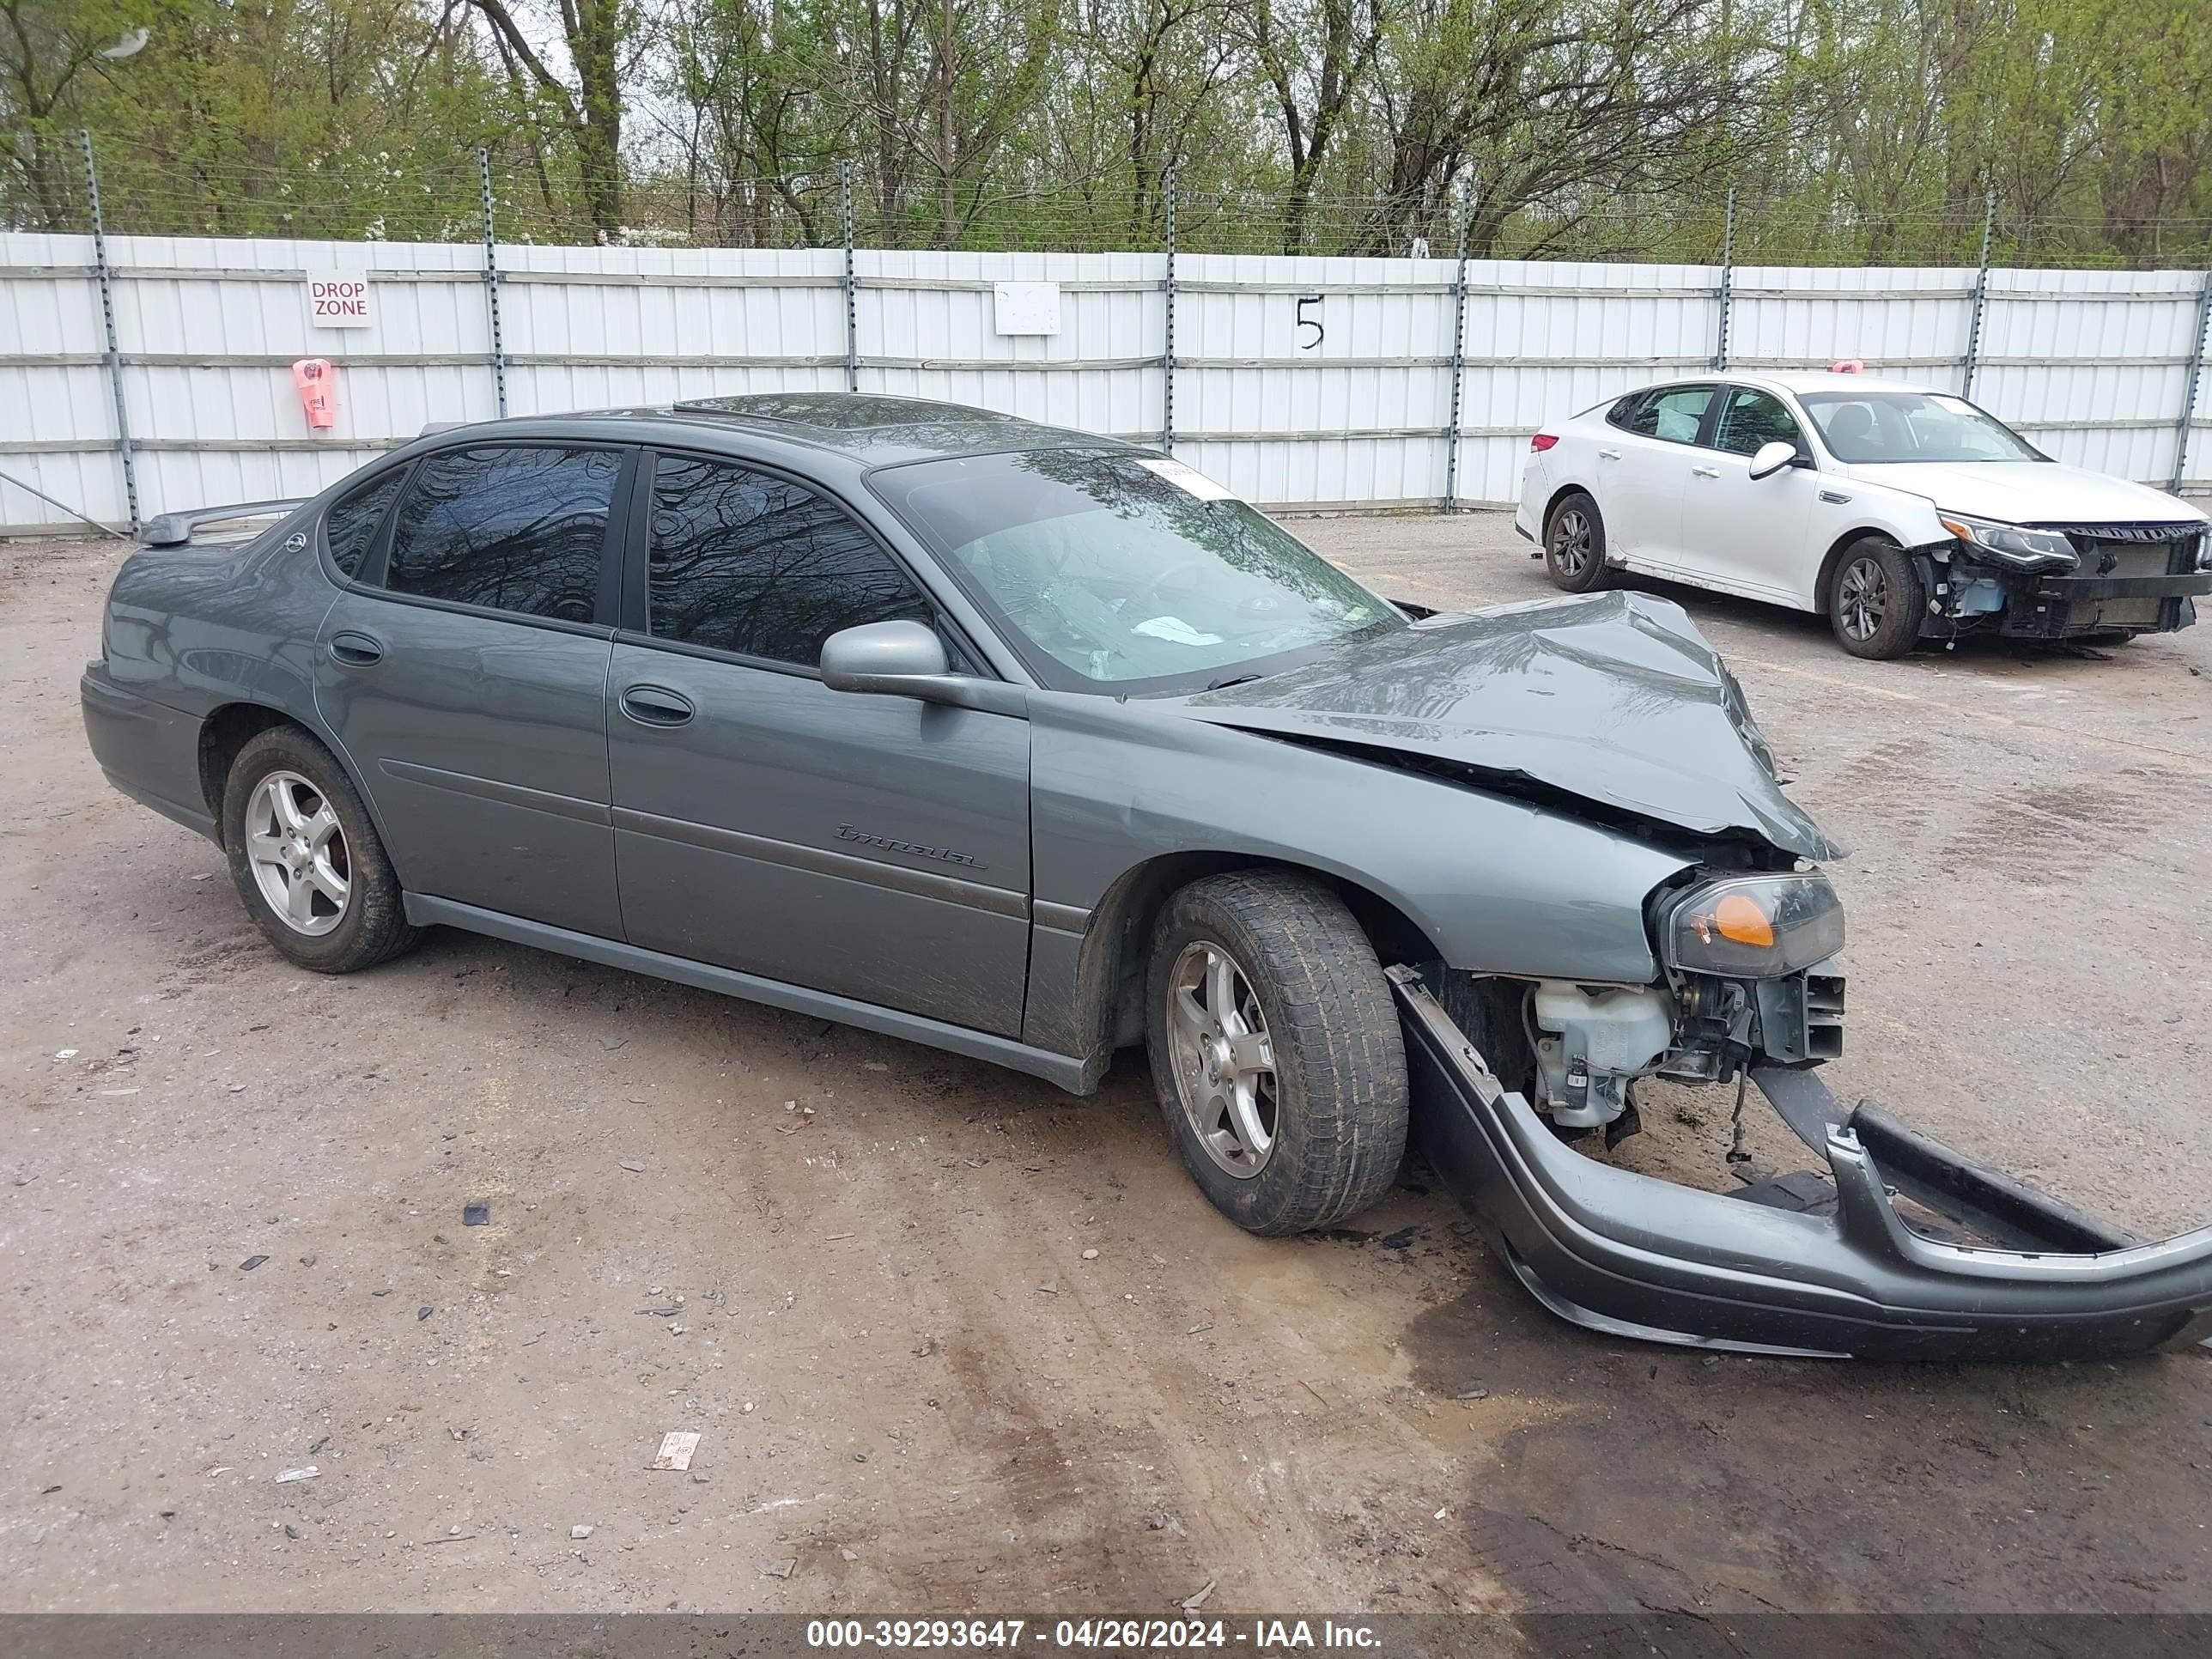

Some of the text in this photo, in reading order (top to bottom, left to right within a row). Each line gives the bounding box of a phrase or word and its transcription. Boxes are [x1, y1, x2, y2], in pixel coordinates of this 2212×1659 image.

[312, 283, 365, 298] DROP
[314, 300, 368, 315] ZONE
[1297, 295, 1325, 349] 5
[833, 822, 989, 870] Impala
